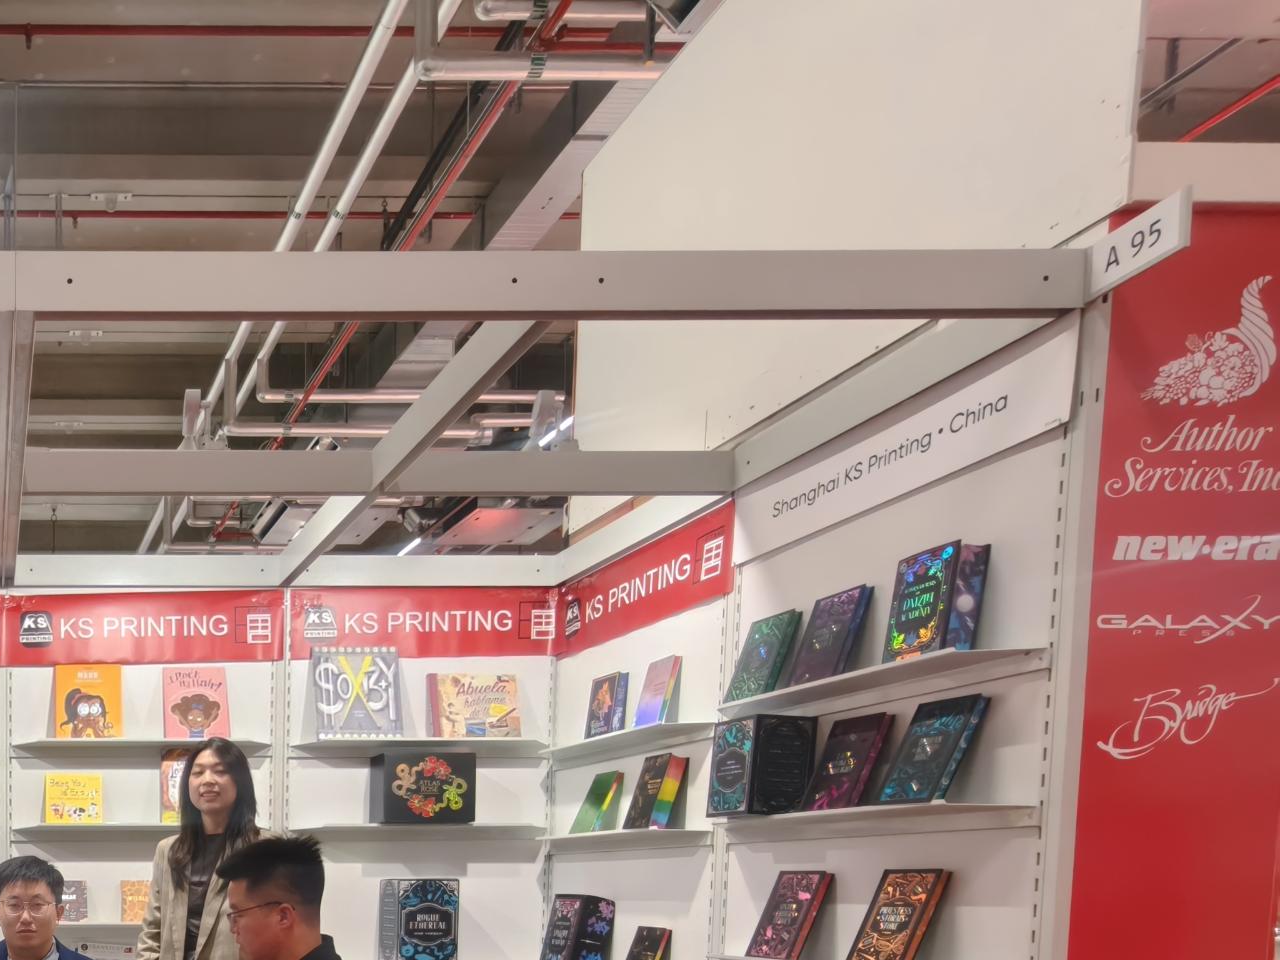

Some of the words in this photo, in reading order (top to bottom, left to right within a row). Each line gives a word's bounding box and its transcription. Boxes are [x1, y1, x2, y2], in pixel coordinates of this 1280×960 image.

[1105, 246, 1119, 272] A
[1131, 219, 1161, 257] 95
[1141, 415, 1273, 452] Author
[772, 473, 840, 518] Shanghai
[845, 462, 863, 485] KS
[868, 432, 931, 473] Printing
[950, 395, 1008, 433] China
[1104, 457, 1233, 498] Services,
[586, 595, 603, 623] KS
[608, 554, 690, 612] PRINTING
[24, 615, 48, 629] KS
[61, 618, 93, 638] KS
[104, 615, 228, 637] PRINTING
[308, 611, 333, 624] KS
[345, 613, 378, 633] KS
[388, 610, 512, 632] PRINTING
[1132, 629, 1235, 637] PRESS
